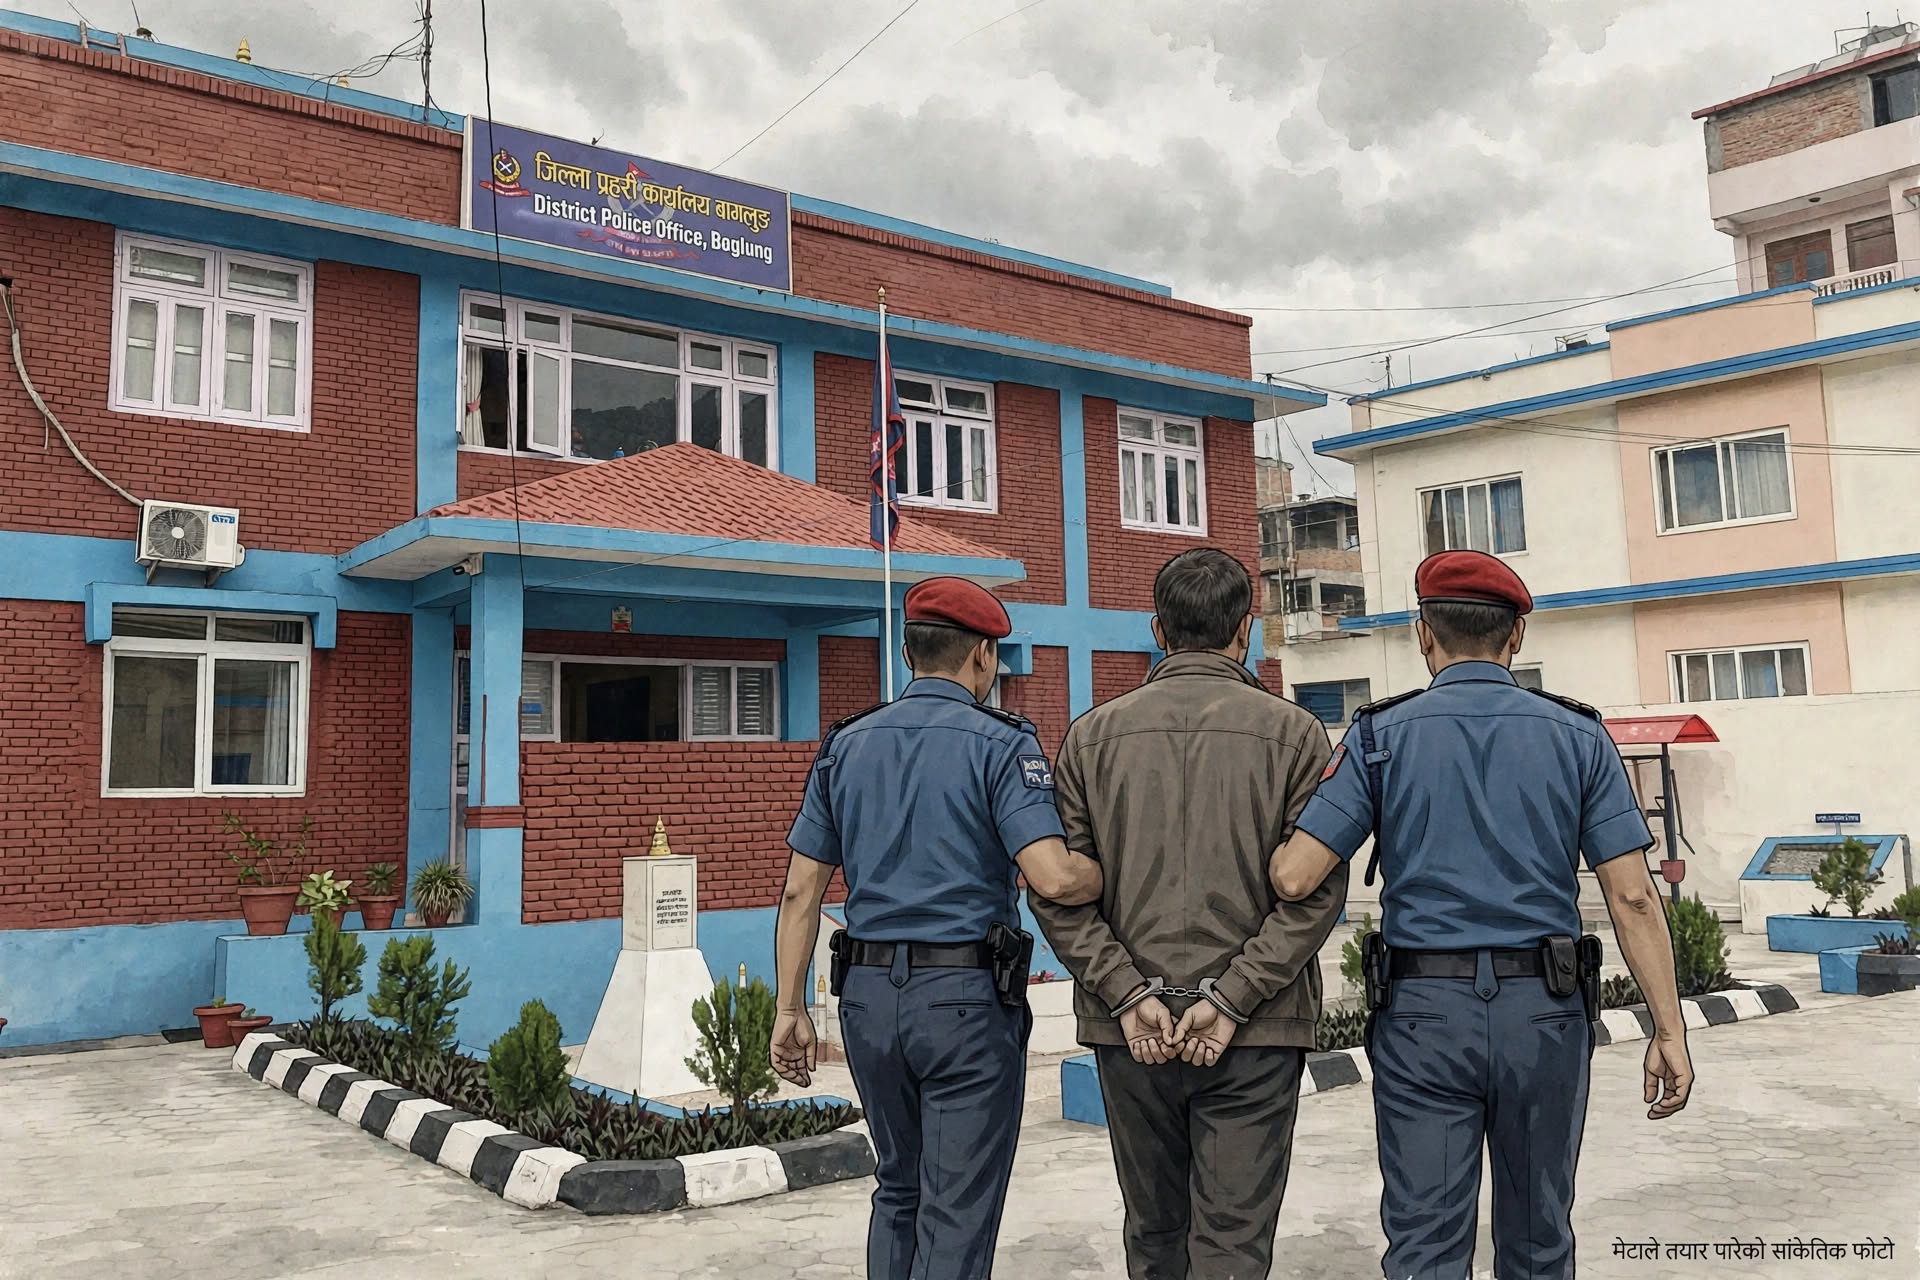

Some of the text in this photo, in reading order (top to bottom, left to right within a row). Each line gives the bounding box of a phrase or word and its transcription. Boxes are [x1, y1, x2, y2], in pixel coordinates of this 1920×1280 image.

[534, 151, 592, 190] जिल्ला
[596, 171, 638, 201] प्रहरी
[641, 182, 711, 217] कार्यालय
[534, 193, 597, 225] District
[601, 209, 652, 237] Police
[655, 219, 708, 251] Office,
[711, 230, 773, 265] Baglung
